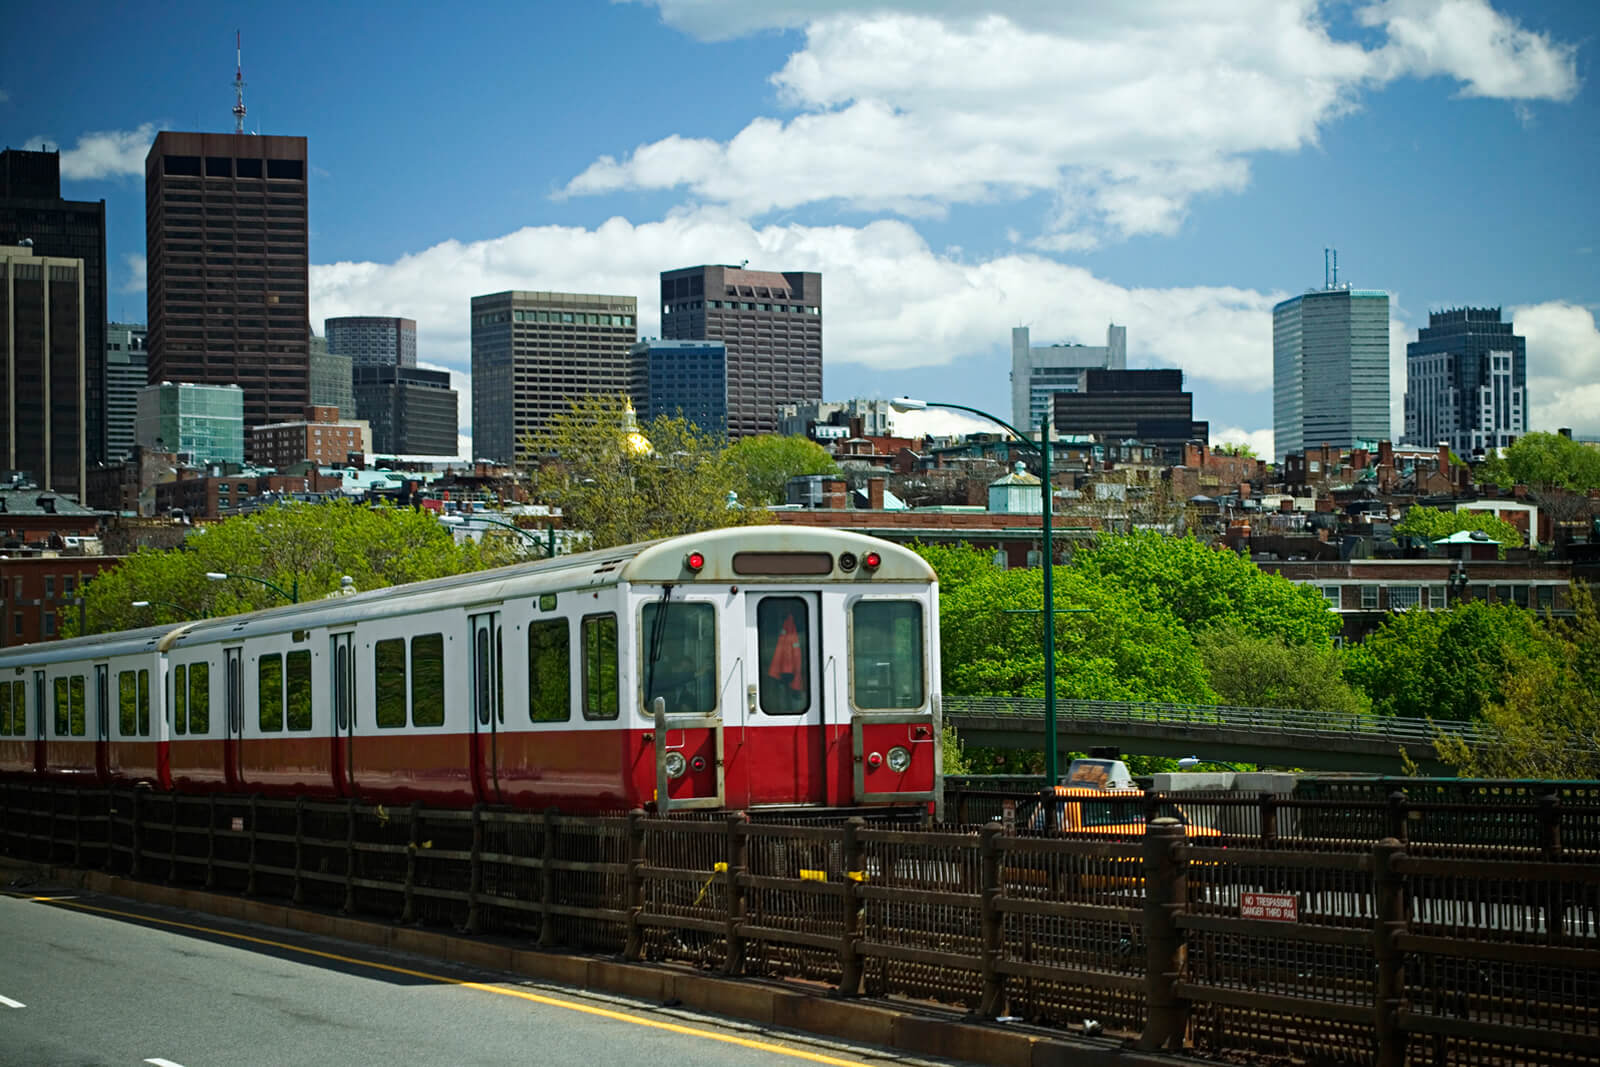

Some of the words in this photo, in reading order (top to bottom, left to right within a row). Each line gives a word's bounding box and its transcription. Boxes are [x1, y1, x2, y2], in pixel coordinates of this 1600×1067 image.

[1245, 896, 1253, 905] NO
[1256, 897, 1293, 908] TRESPASSING
[1242, 906, 1264, 915] DANGER
[1266, 908, 1281, 917] THIRD
[1284, 909, 1296, 919] RAIL
